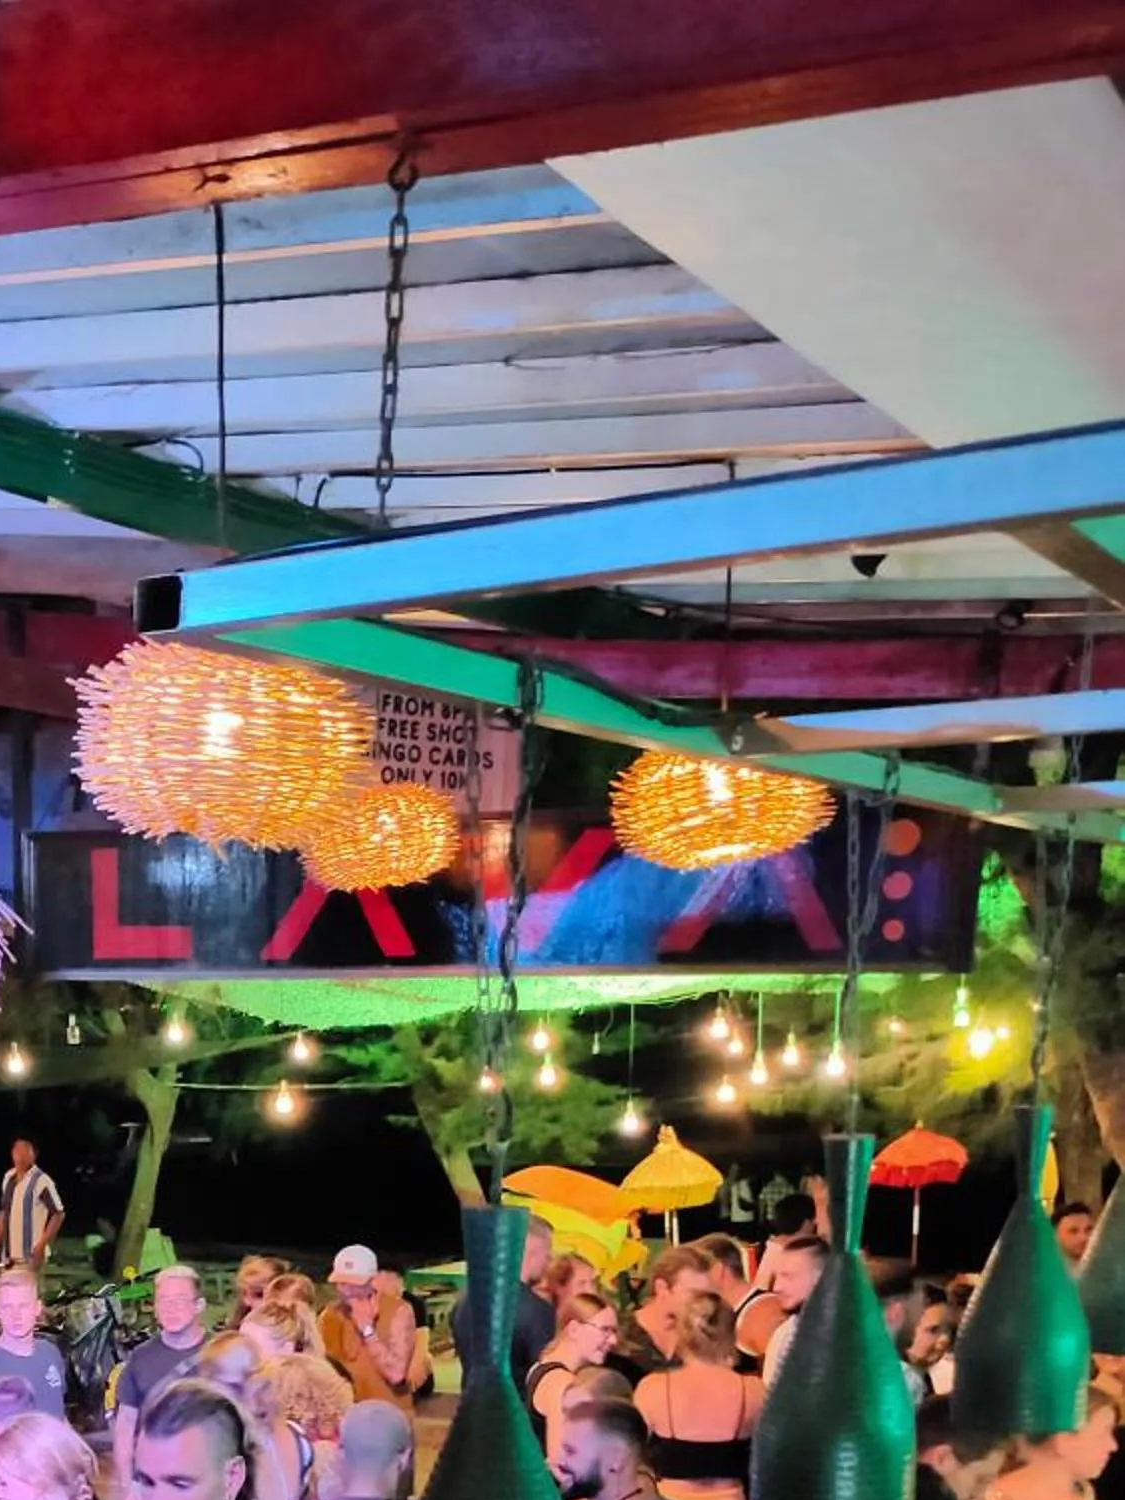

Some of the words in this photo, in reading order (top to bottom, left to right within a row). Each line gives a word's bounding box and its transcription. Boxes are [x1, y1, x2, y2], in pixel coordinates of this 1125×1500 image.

[382, 694, 435, 718] FROM
[377, 718, 420, 740] FREE
[359, 741, 422, 763] INGO
